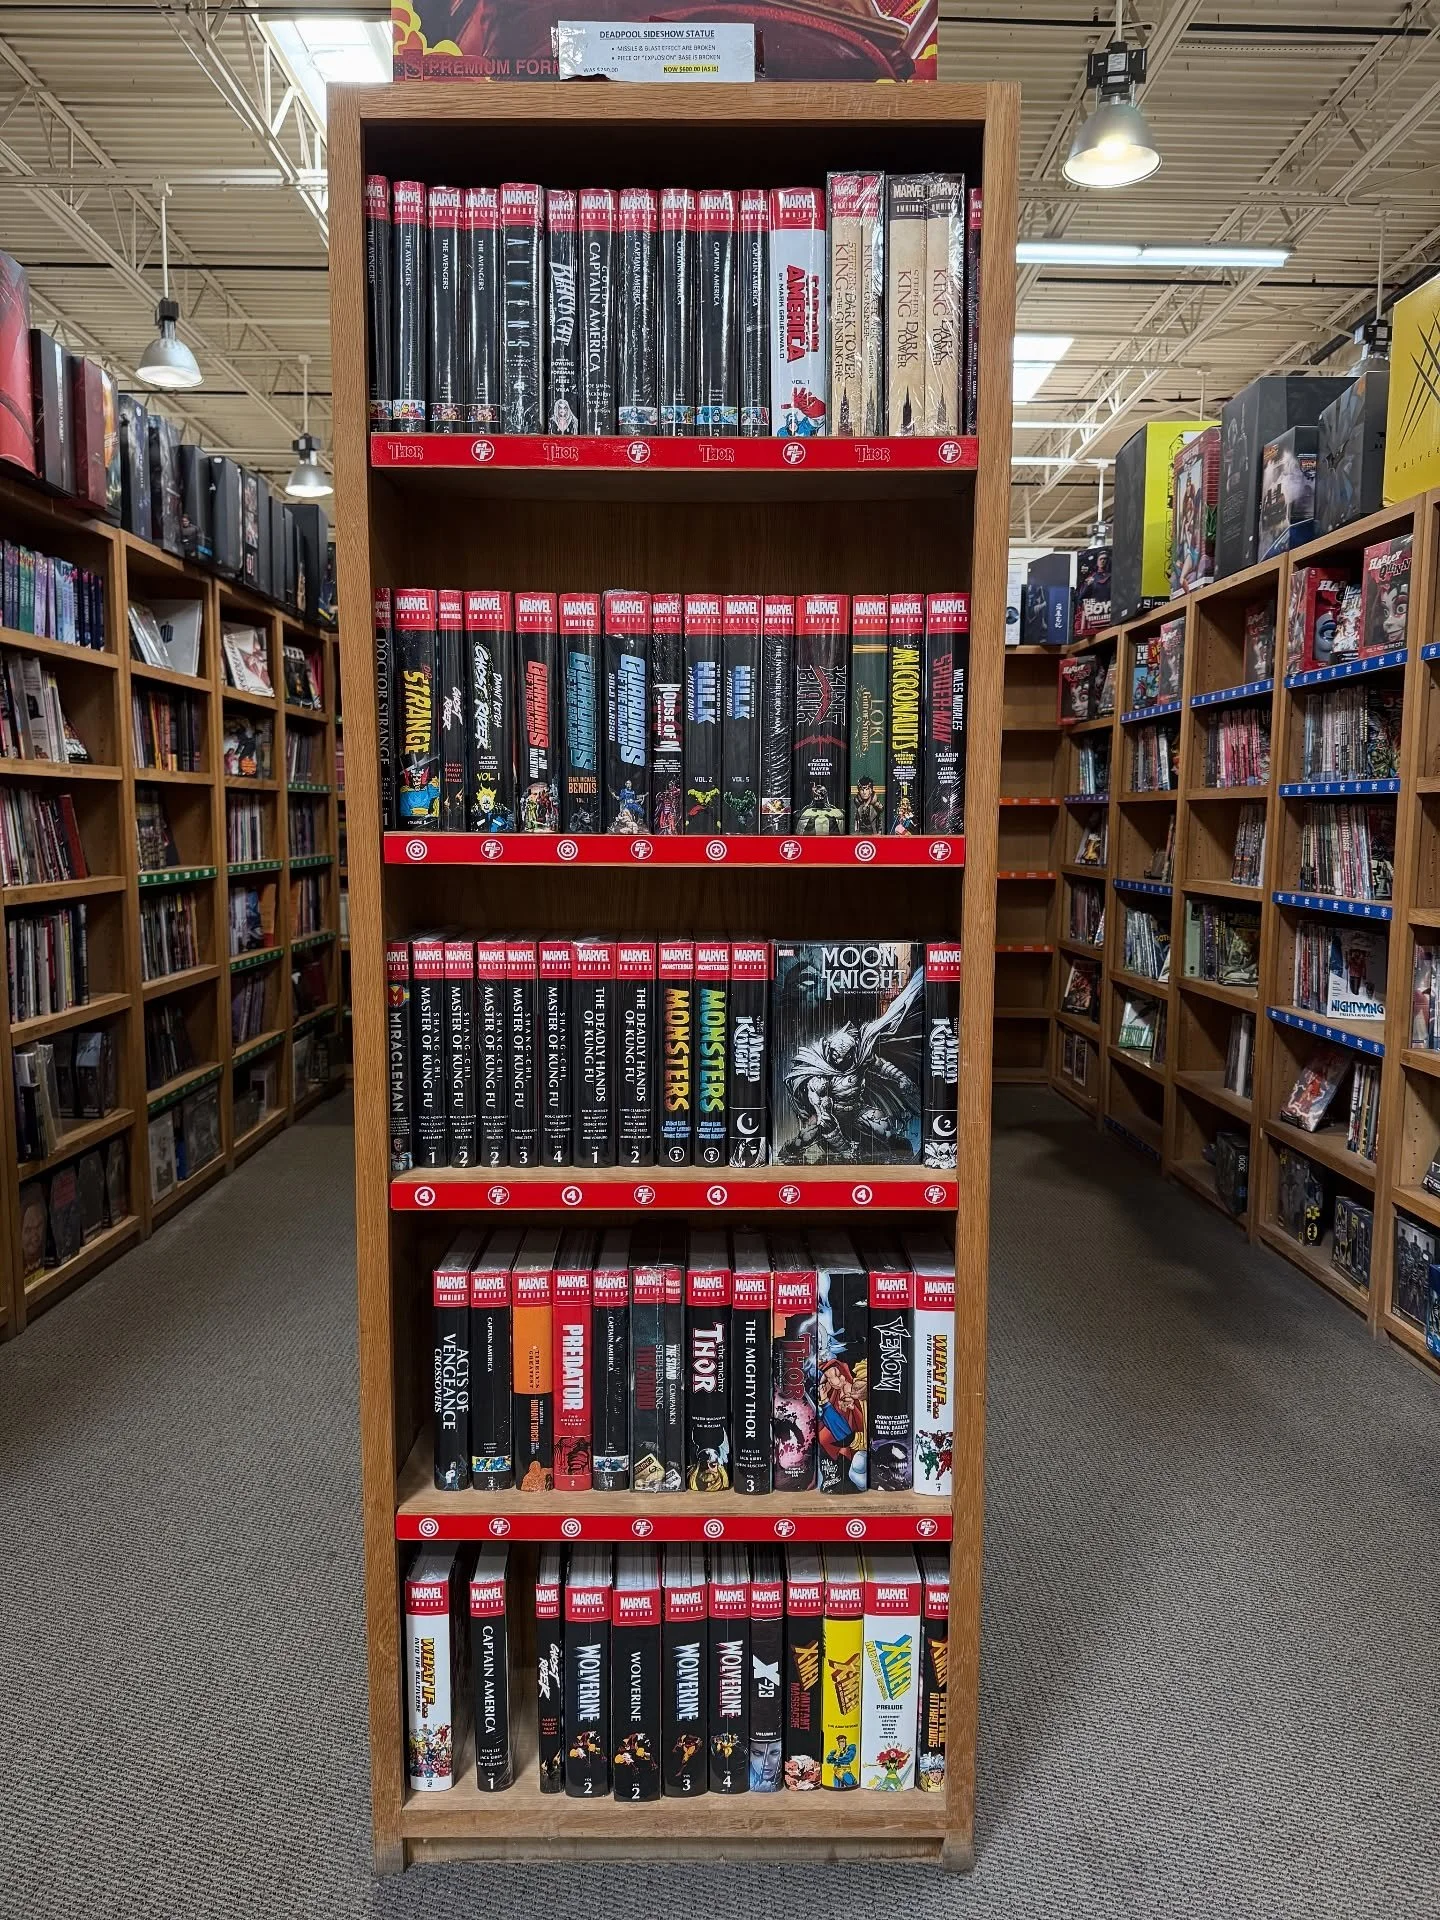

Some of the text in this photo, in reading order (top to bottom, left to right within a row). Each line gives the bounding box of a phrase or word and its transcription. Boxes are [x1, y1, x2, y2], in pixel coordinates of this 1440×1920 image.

[599, 30, 715, 39] DEADPOOL SIDESHOW STATUE
[429, 59, 510, 75] PREMIUM
[663, 65, 680, 73] NOW
[502, 190, 536, 205] MARVEL
[507, 238, 531, 347] ALIENS
[589, 242, 601, 373] CAPTAIN AMERICA
[786, 265, 806, 363] AMERICA
[897, 270, 911, 318] KING
[387, 441, 424, 461] THOR
[543, 442, 580, 461] THOR
[699, 445, 736, 463] THOR
[854, 444, 891, 463] THOR
[1368, 550, 1403, 571] HARLEY
[1379, 558, 1412, 581] QUINN
[396, 597, 429, 610] MARVEL
[470, 598, 501, 610] MARVEL
[519, 600, 552, 613] MARVEL
[403, 670, 432, 755] STRANGE
[527, 660, 549, 748] GUARDIANS
[569, 652, 596, 770] GUARDIANS
[620, 653, 647, 767] GUARDIANS
[697, 661, 716, 725] HULK
[734, 665, 751, 720] HULK
[891, 646, 920, 751] MICRONAUTS
[931, 653, 953, 743] SPIDER-MAN
[952, 668, 964, 731] MILES MORALES
[869, 700, 885, 744] LOKI
[568, 782, 597, 794] BENDIS
[415, 950, 443, 961] MARVEL
[446, 950, 473, 961] MARVEL
[480, 951, 506, 962] MARVEL
[820, 946, 897, 972] MOON
[824, 969, 905, 1001] KNIGHT
[1331, 1000, 1385, 1015] NIGHTWING
[389, 1012, 404, 1112] MIRACLEMAN
[420, 986, 433, 1108] MASTER OF KUNG FU
[451, 986, 464, 1108] MASTER OF KUNG FU
[547, 986, 559, 1108] MASTER OF KUNG FU
[583, 1010, 594, 1083] OF KUNG FU
[595, 986, 606, 1102] THE DEADLY HANDS
[625, 1010, 635, 1083] OF KUNG FU
[636, 987, 646, 1102] THE DEADLY HANDS
[664, 988, 690, 1111] MONSTERS
[700, 988, 726, 1112] MONSTERS
[429, 1151, 436, 1164] 1
[519, 1151, 528, 1164] 3
[553, 1150, 563, 1163] 4
[592, 1151, 599, 1163] 1
[630, 1151, 640, 1163] 2
[436, 1276, 467, 1289] MARVEL
[474, 1277, 505, 1290] MARVEL
[518, 1277, 548, 1290] MARVEL
[562, 1324, 584, 1411] PREDATOR
[692, 1322, 724, 1393] THOR
[777, 1332, 812, 1401] THOR
[872, 1315, 911, 1393] VENOM
[434, 1348, 442, 1413] CROSSOVERS
[442, 1333, 456, 1430] VENGEANCE
[456, 1349, 469, 1413] ACTS OF
[655, 1344, 664, 1410] STEPHEN KING
[745, 1319, 756, 1439] THE MIGHTY THOR
[530, 1399, 539, 1442] HUMAN TORCH
[669, 1383, 677, 1425] COMPANION
[411, 1587, 442, 1600] MARVEL
[472, 1588, 502, 1601] MARVEL
[536, 1588, 559, 1603] MARVEL
[482, 1625, 495, 1734] CAPTAIN AMERICA
[576, 1644, 602, 1722] WOLVERINE
[630, 1651, 642, 1722] WOLVERINE
[672, 1642, 701, 1722] WOLVERINE
[715, 1640, 744, 1719] WOLVERINE
[752, 1654, 781, 1698] X-23
[874, 1634, 913, 1701] X-MEN
[799, 1691, 811, 1731] MUTANT
[927, 1692, 939, 1748] ATTRACTIONS
[487, 1777, 495, 1790] 1
[583, 1781, 593, 1794] 2
[631, 1787, 641, 1800] 2
[682, 1778, 692, 1791] 3
[722, 1775, 733, 1788] 4
